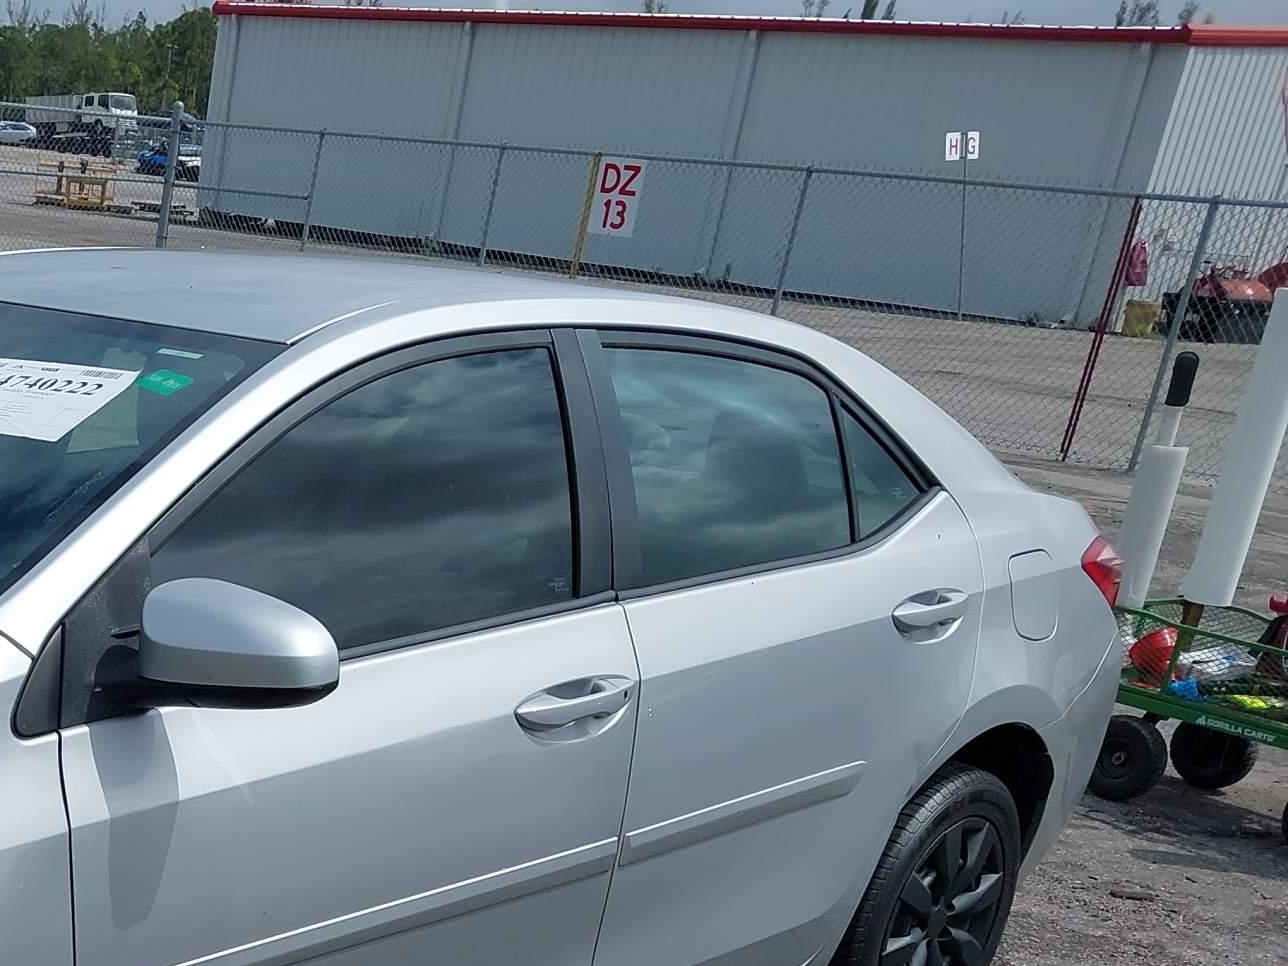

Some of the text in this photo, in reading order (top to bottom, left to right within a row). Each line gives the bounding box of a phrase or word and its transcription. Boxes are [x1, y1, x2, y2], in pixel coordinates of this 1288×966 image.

[949, 136, 976, 156] H G
[599, 162, 642, 197] DZ
[601, 198, 627, 230] 13
[1206, 718, 1242, 734] GORILLA
